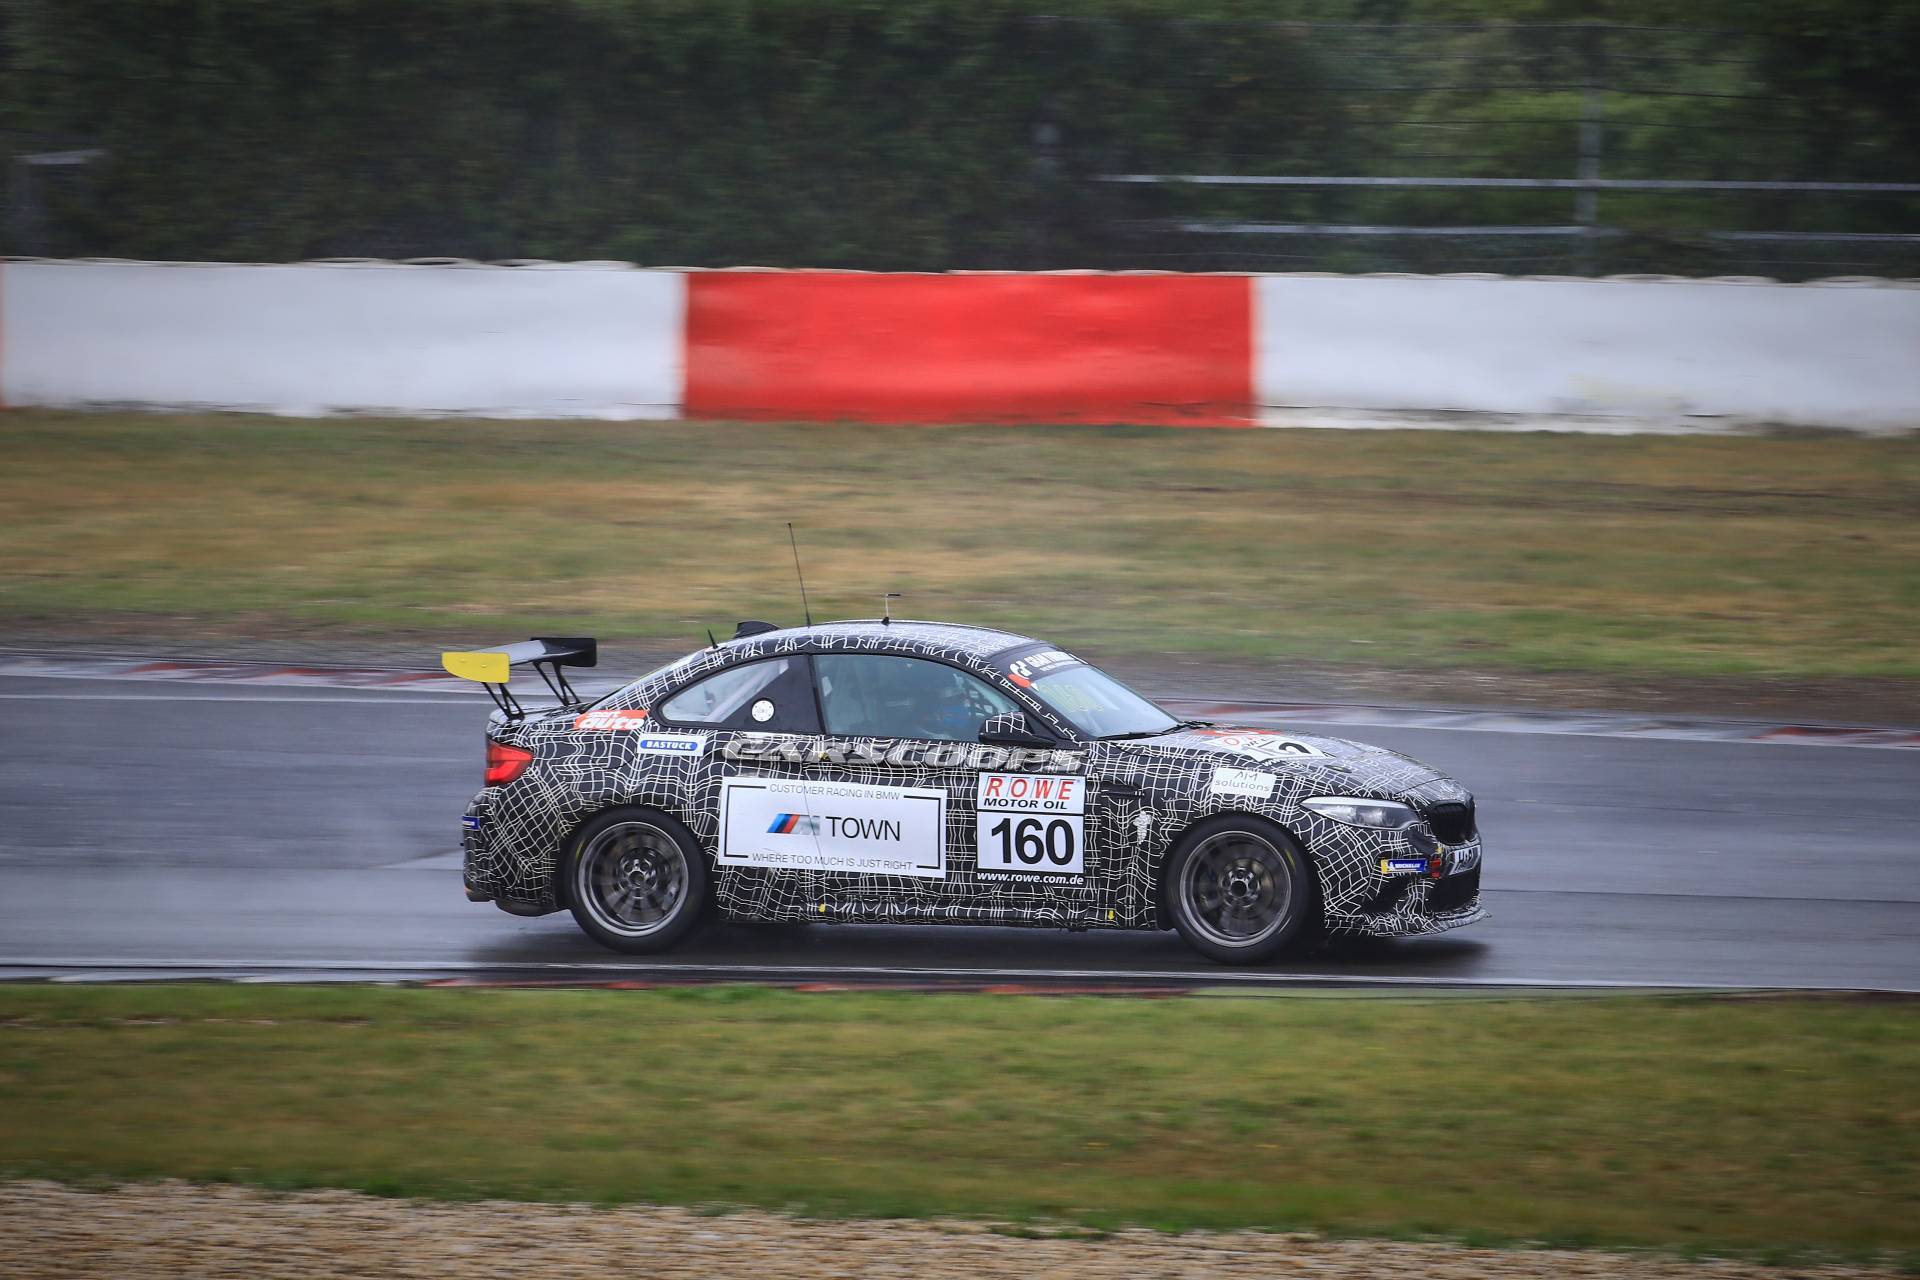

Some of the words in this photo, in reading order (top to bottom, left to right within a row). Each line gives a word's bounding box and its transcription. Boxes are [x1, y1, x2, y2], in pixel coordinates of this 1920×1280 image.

[578, 718, 645, 729] auto
[645, 740, 693, 750] BASTUCK
[769, 784, 824, 795] CUSTOMER
[826, 787, 862, 798] RACING
[864, 790, 874, 799] IN
[876, 791, 900, 800] BMW
[986, 777, 1074, 800] ROWE
[1214, 779, 1270, 792] solutions
[984, 797, 1038, 808] MOTOR
[1043, 800, 1068, 809] OIL
[825, 816, 900, 841] TOWN
[991, 818, 1075, 866] 160
[752, 852, 787, 863] WHERE
[790, 854, 812, 865] TOO
[814, 855, 843, 866] MUCH
[846, 857, 855, 866] IS
[856, 858, 882, 868] JUST
[883, 860, 913, 870] RIGHT
[977, 872, 1084, 885] www.rowe.com.de
